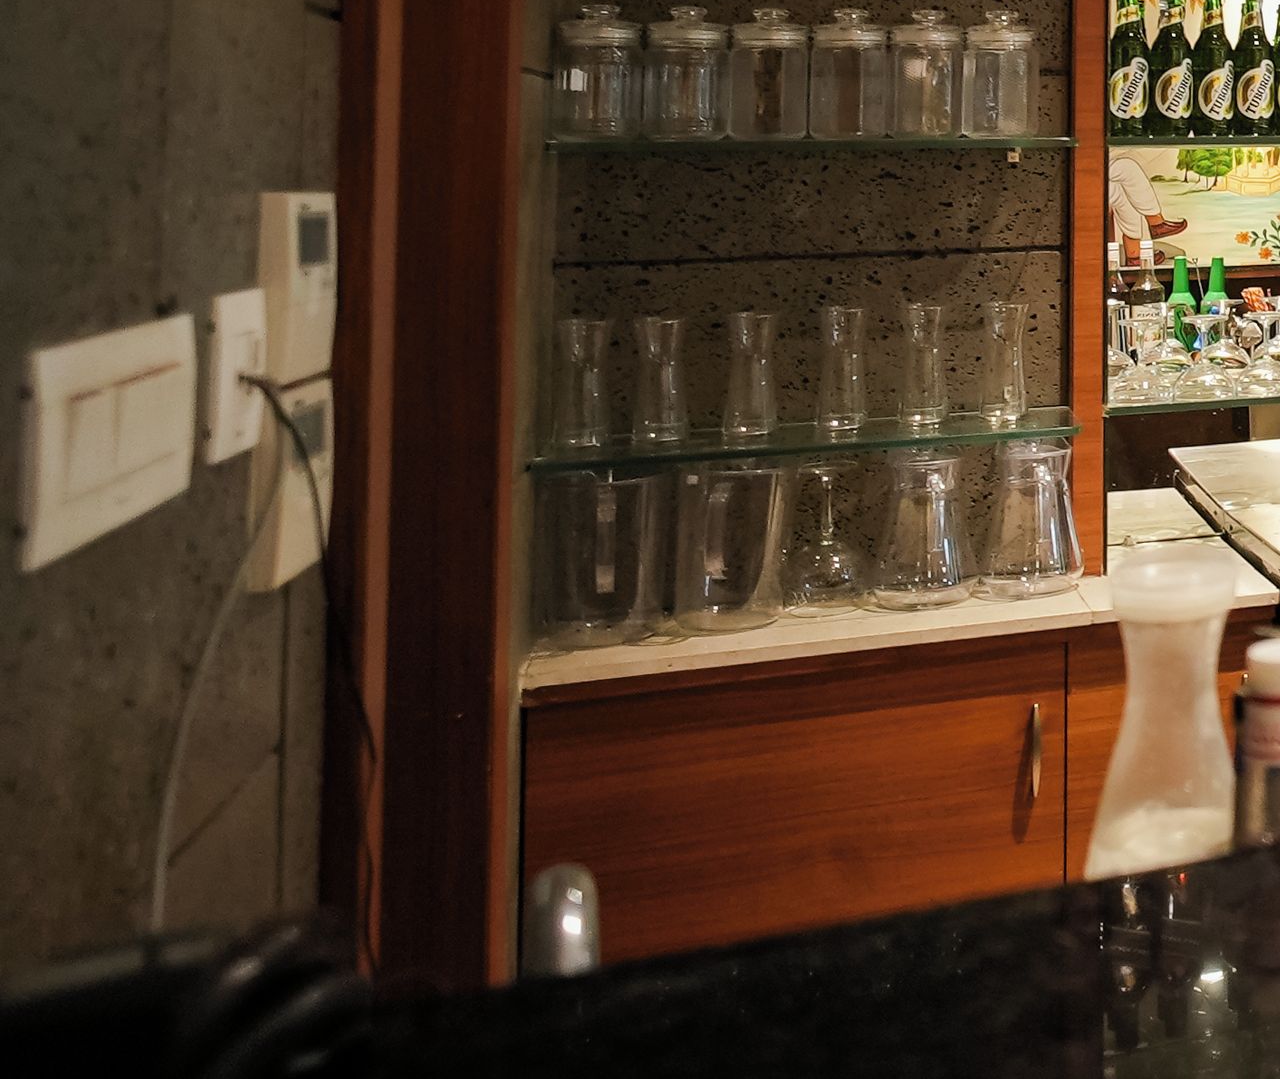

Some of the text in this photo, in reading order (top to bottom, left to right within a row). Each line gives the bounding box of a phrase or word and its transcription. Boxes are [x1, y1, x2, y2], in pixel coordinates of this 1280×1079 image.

[1116, 71, 1144, 114] TUBORG
[1165, 72, 1191, 114] TUBORG
[1208, 73, 1233, 116] TUBORG
[1245, 72, 1272, 115] TUBORG
